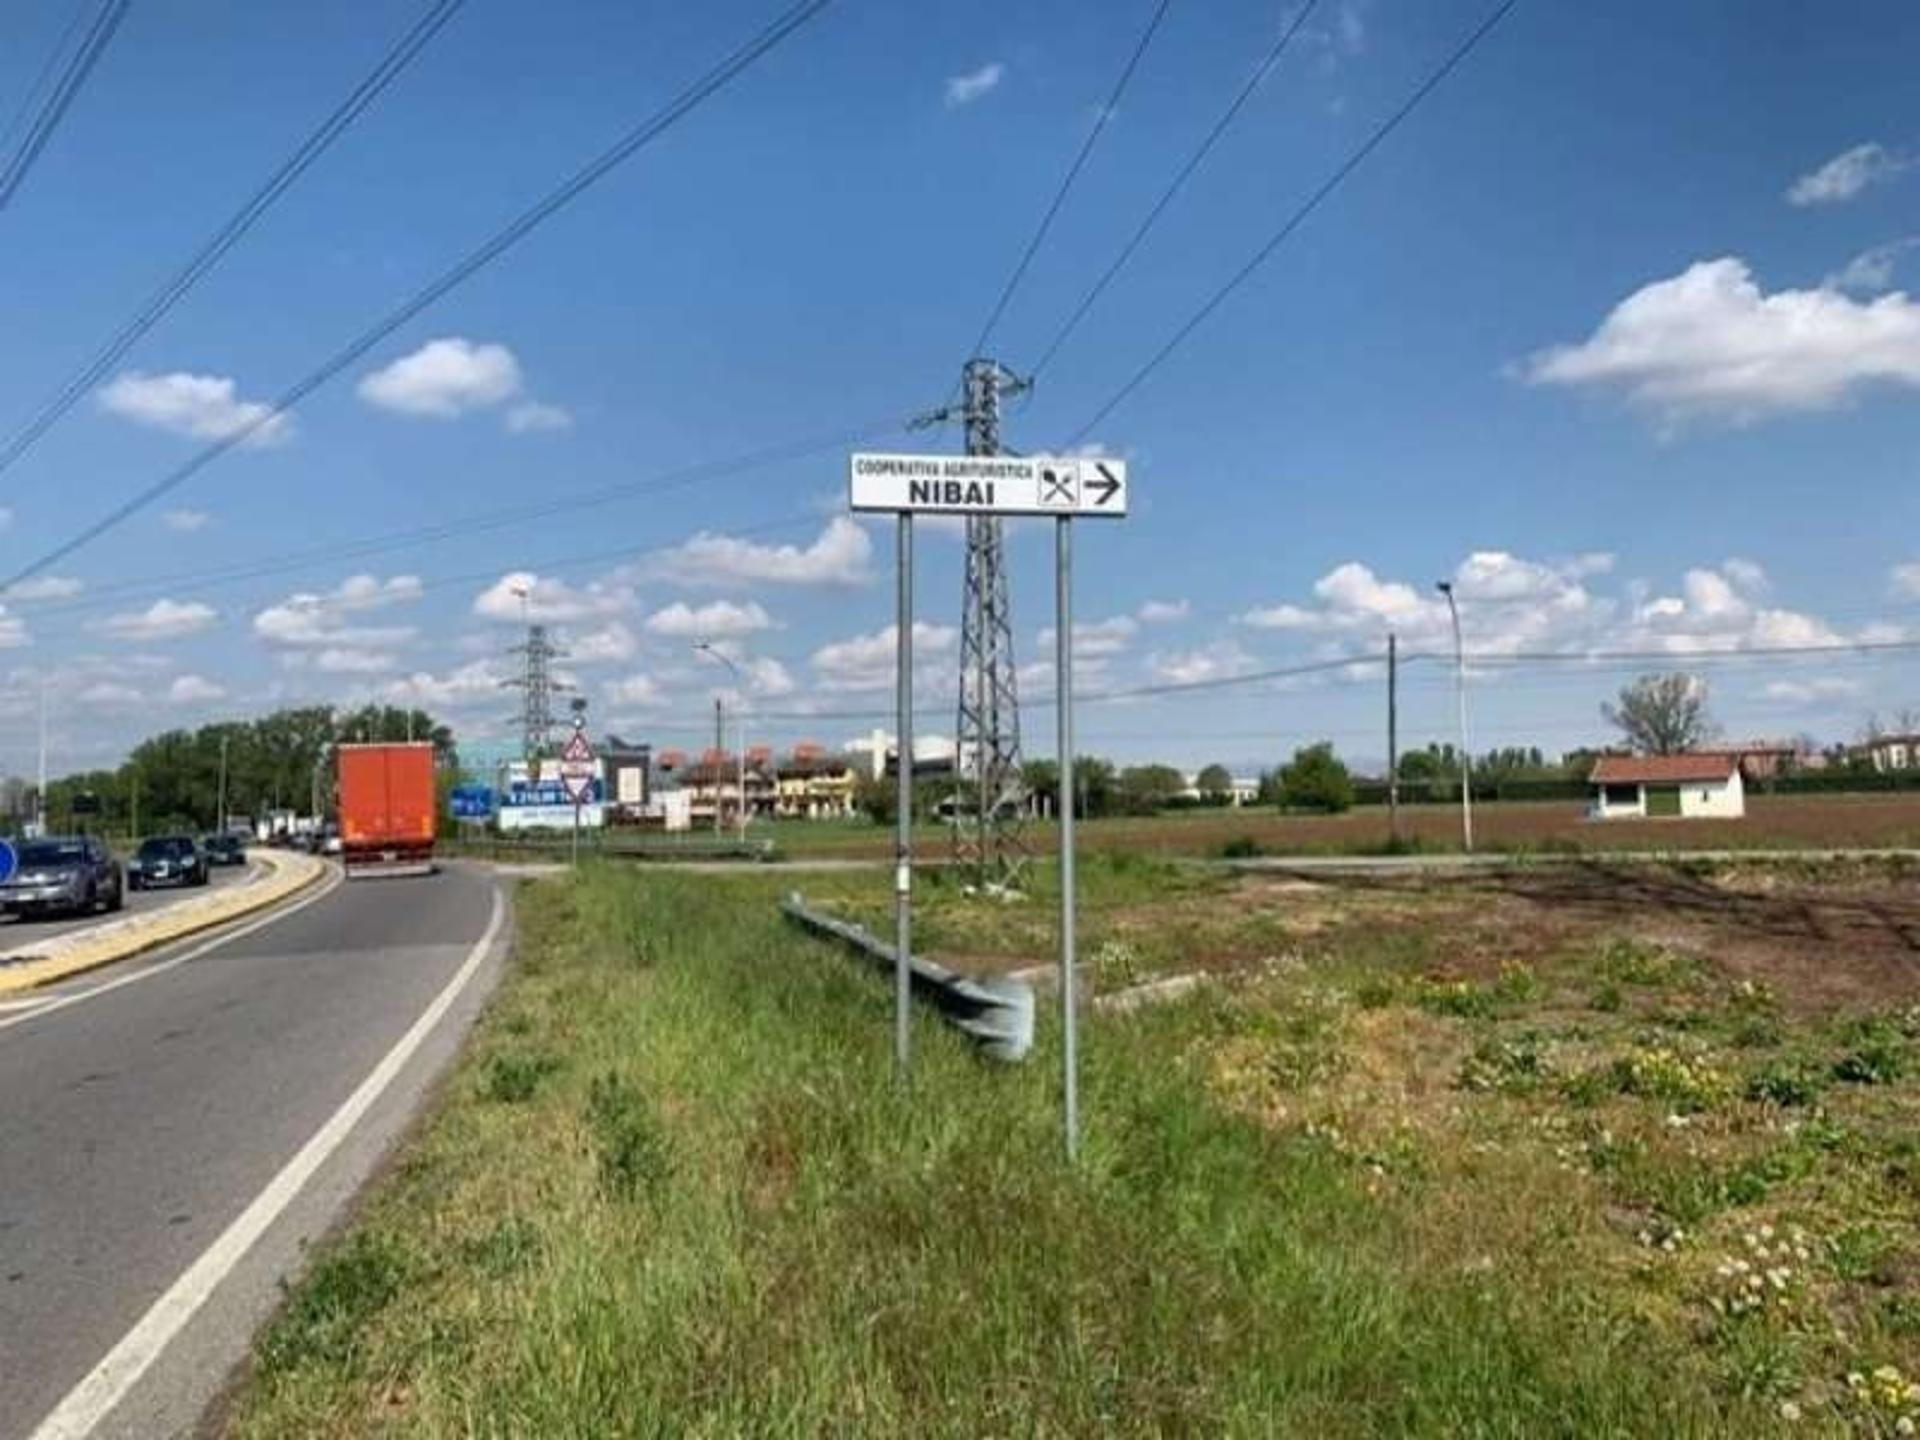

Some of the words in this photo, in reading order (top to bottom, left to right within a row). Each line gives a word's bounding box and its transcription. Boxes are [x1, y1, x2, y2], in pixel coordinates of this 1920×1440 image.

[856, 459, 939, 477] COOPERATIVA
[944, 460, 1033, 479] AGRITURISTICA
[909, 480, 995, 504] NIBAI
